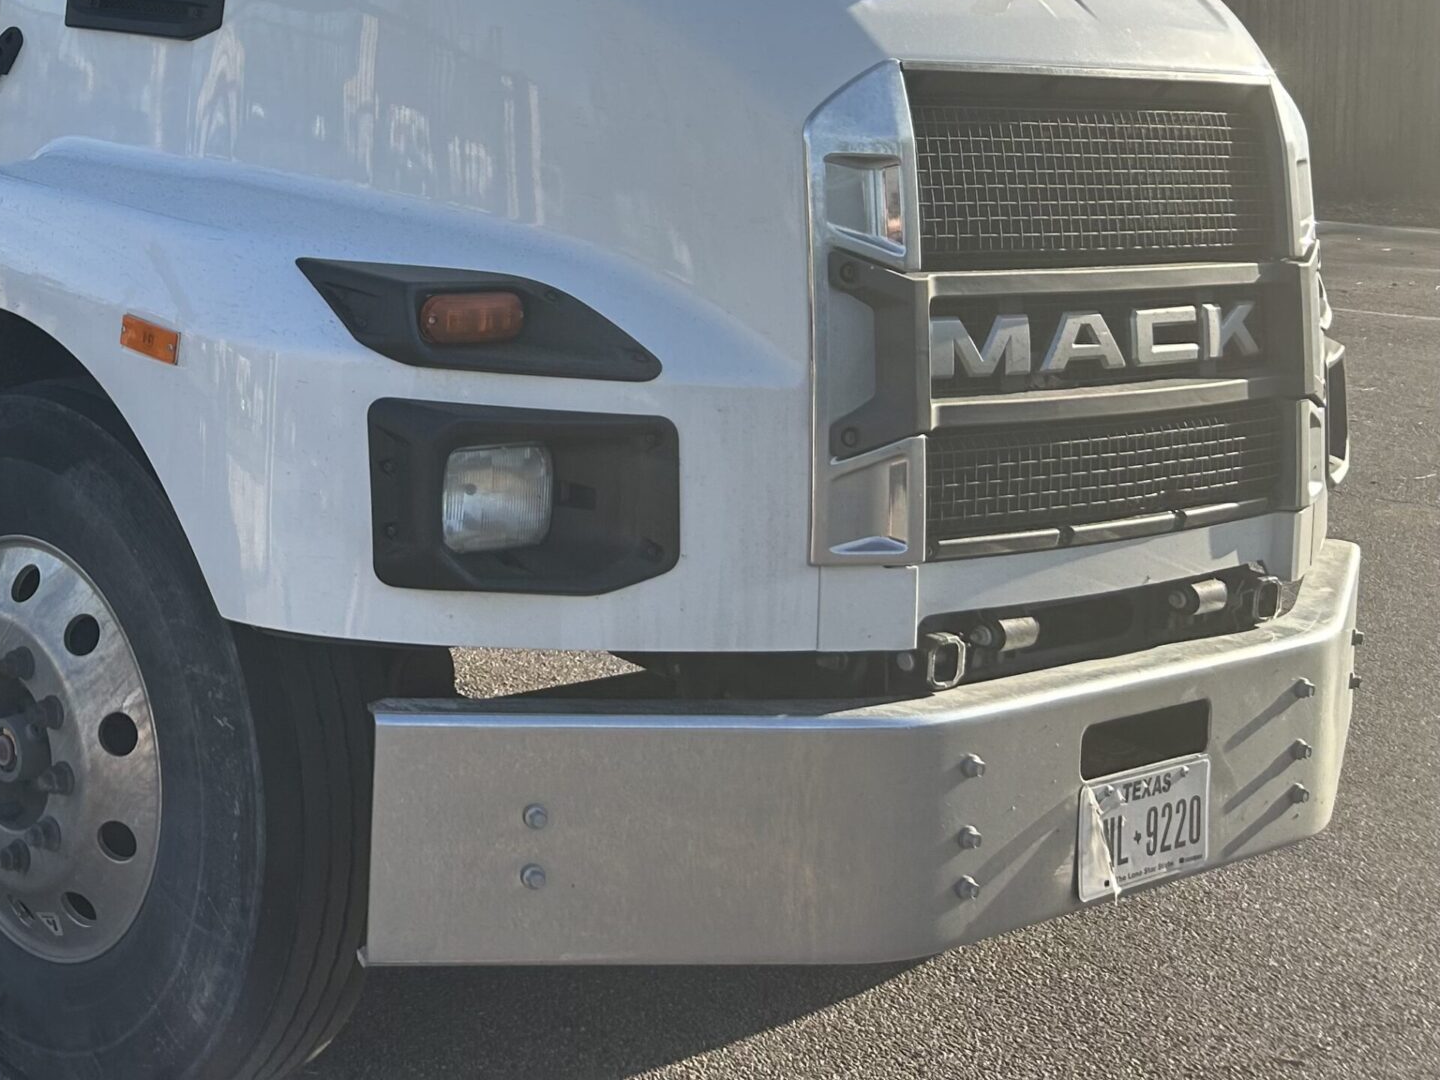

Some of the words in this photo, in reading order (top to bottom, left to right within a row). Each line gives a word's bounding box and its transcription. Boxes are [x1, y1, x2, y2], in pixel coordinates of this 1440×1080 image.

[930, 300, 1259, 379] MACK
[1122, 772, 1172, 803] TEXAS
[1146, 795, 1201, 857] 9220
